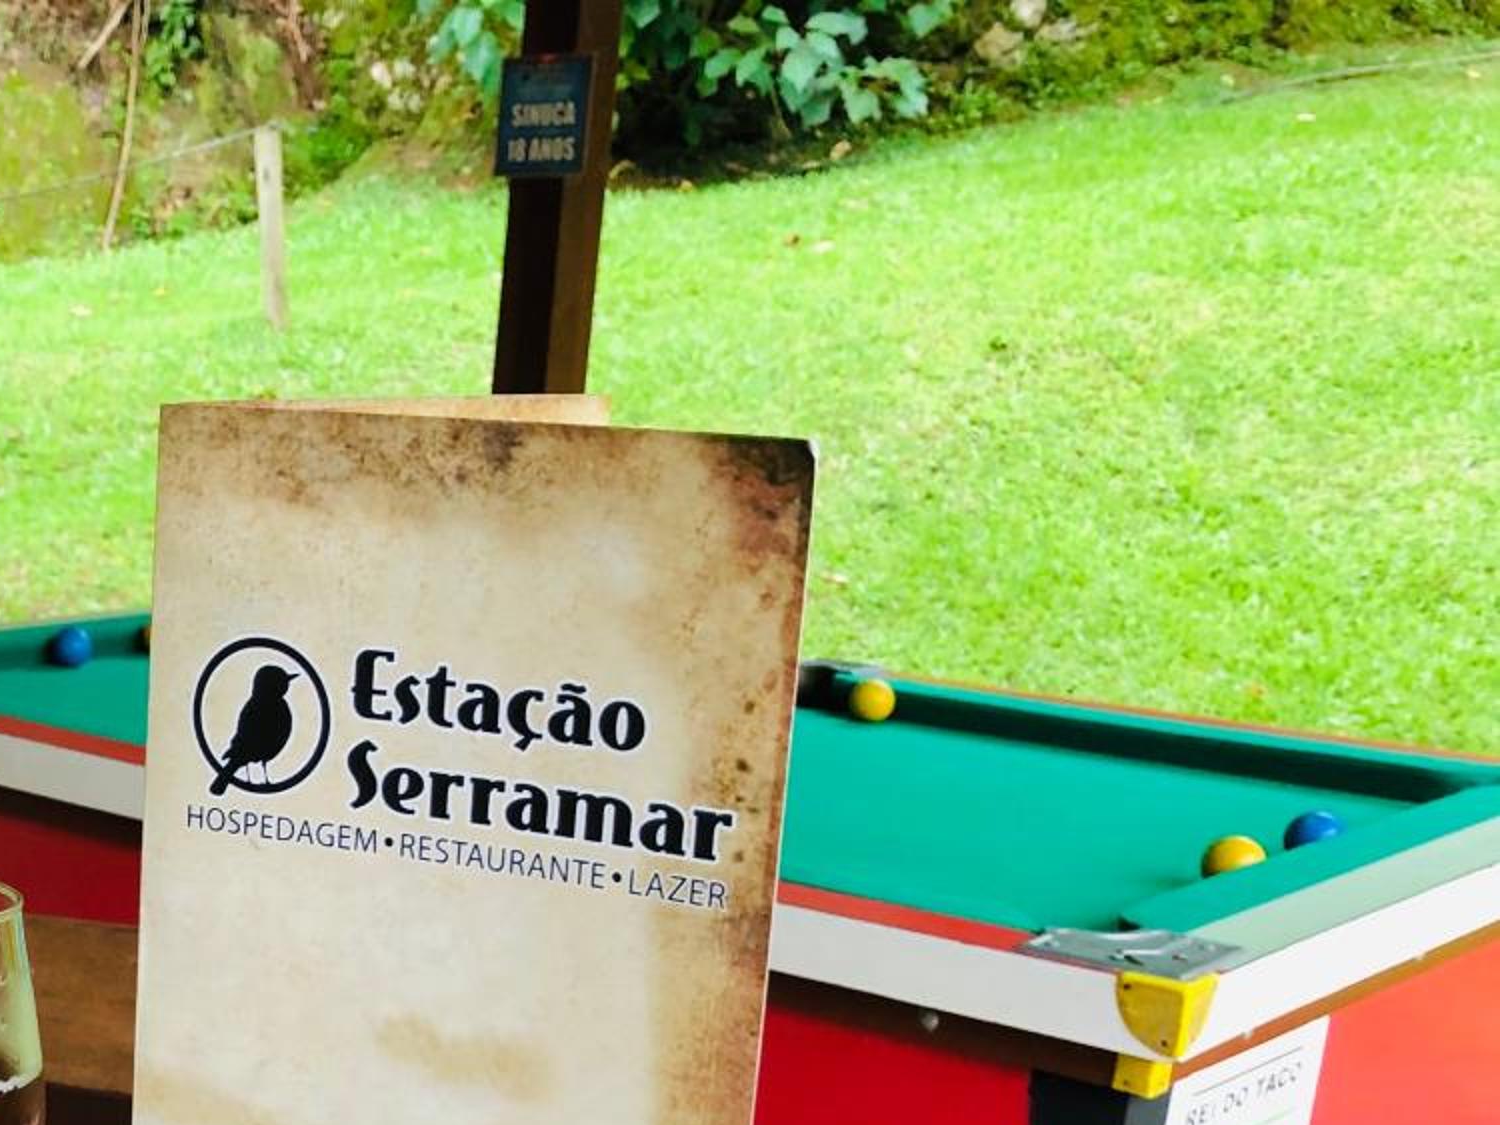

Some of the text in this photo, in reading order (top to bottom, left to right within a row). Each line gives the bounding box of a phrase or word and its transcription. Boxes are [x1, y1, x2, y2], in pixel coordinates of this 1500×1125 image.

[352, 649, 645, 752] Estação
[347, 739, 733, 862] Serramar
[187, 804, 728, 910] HOSPEDAGEM RESTAURANTE LAZER
